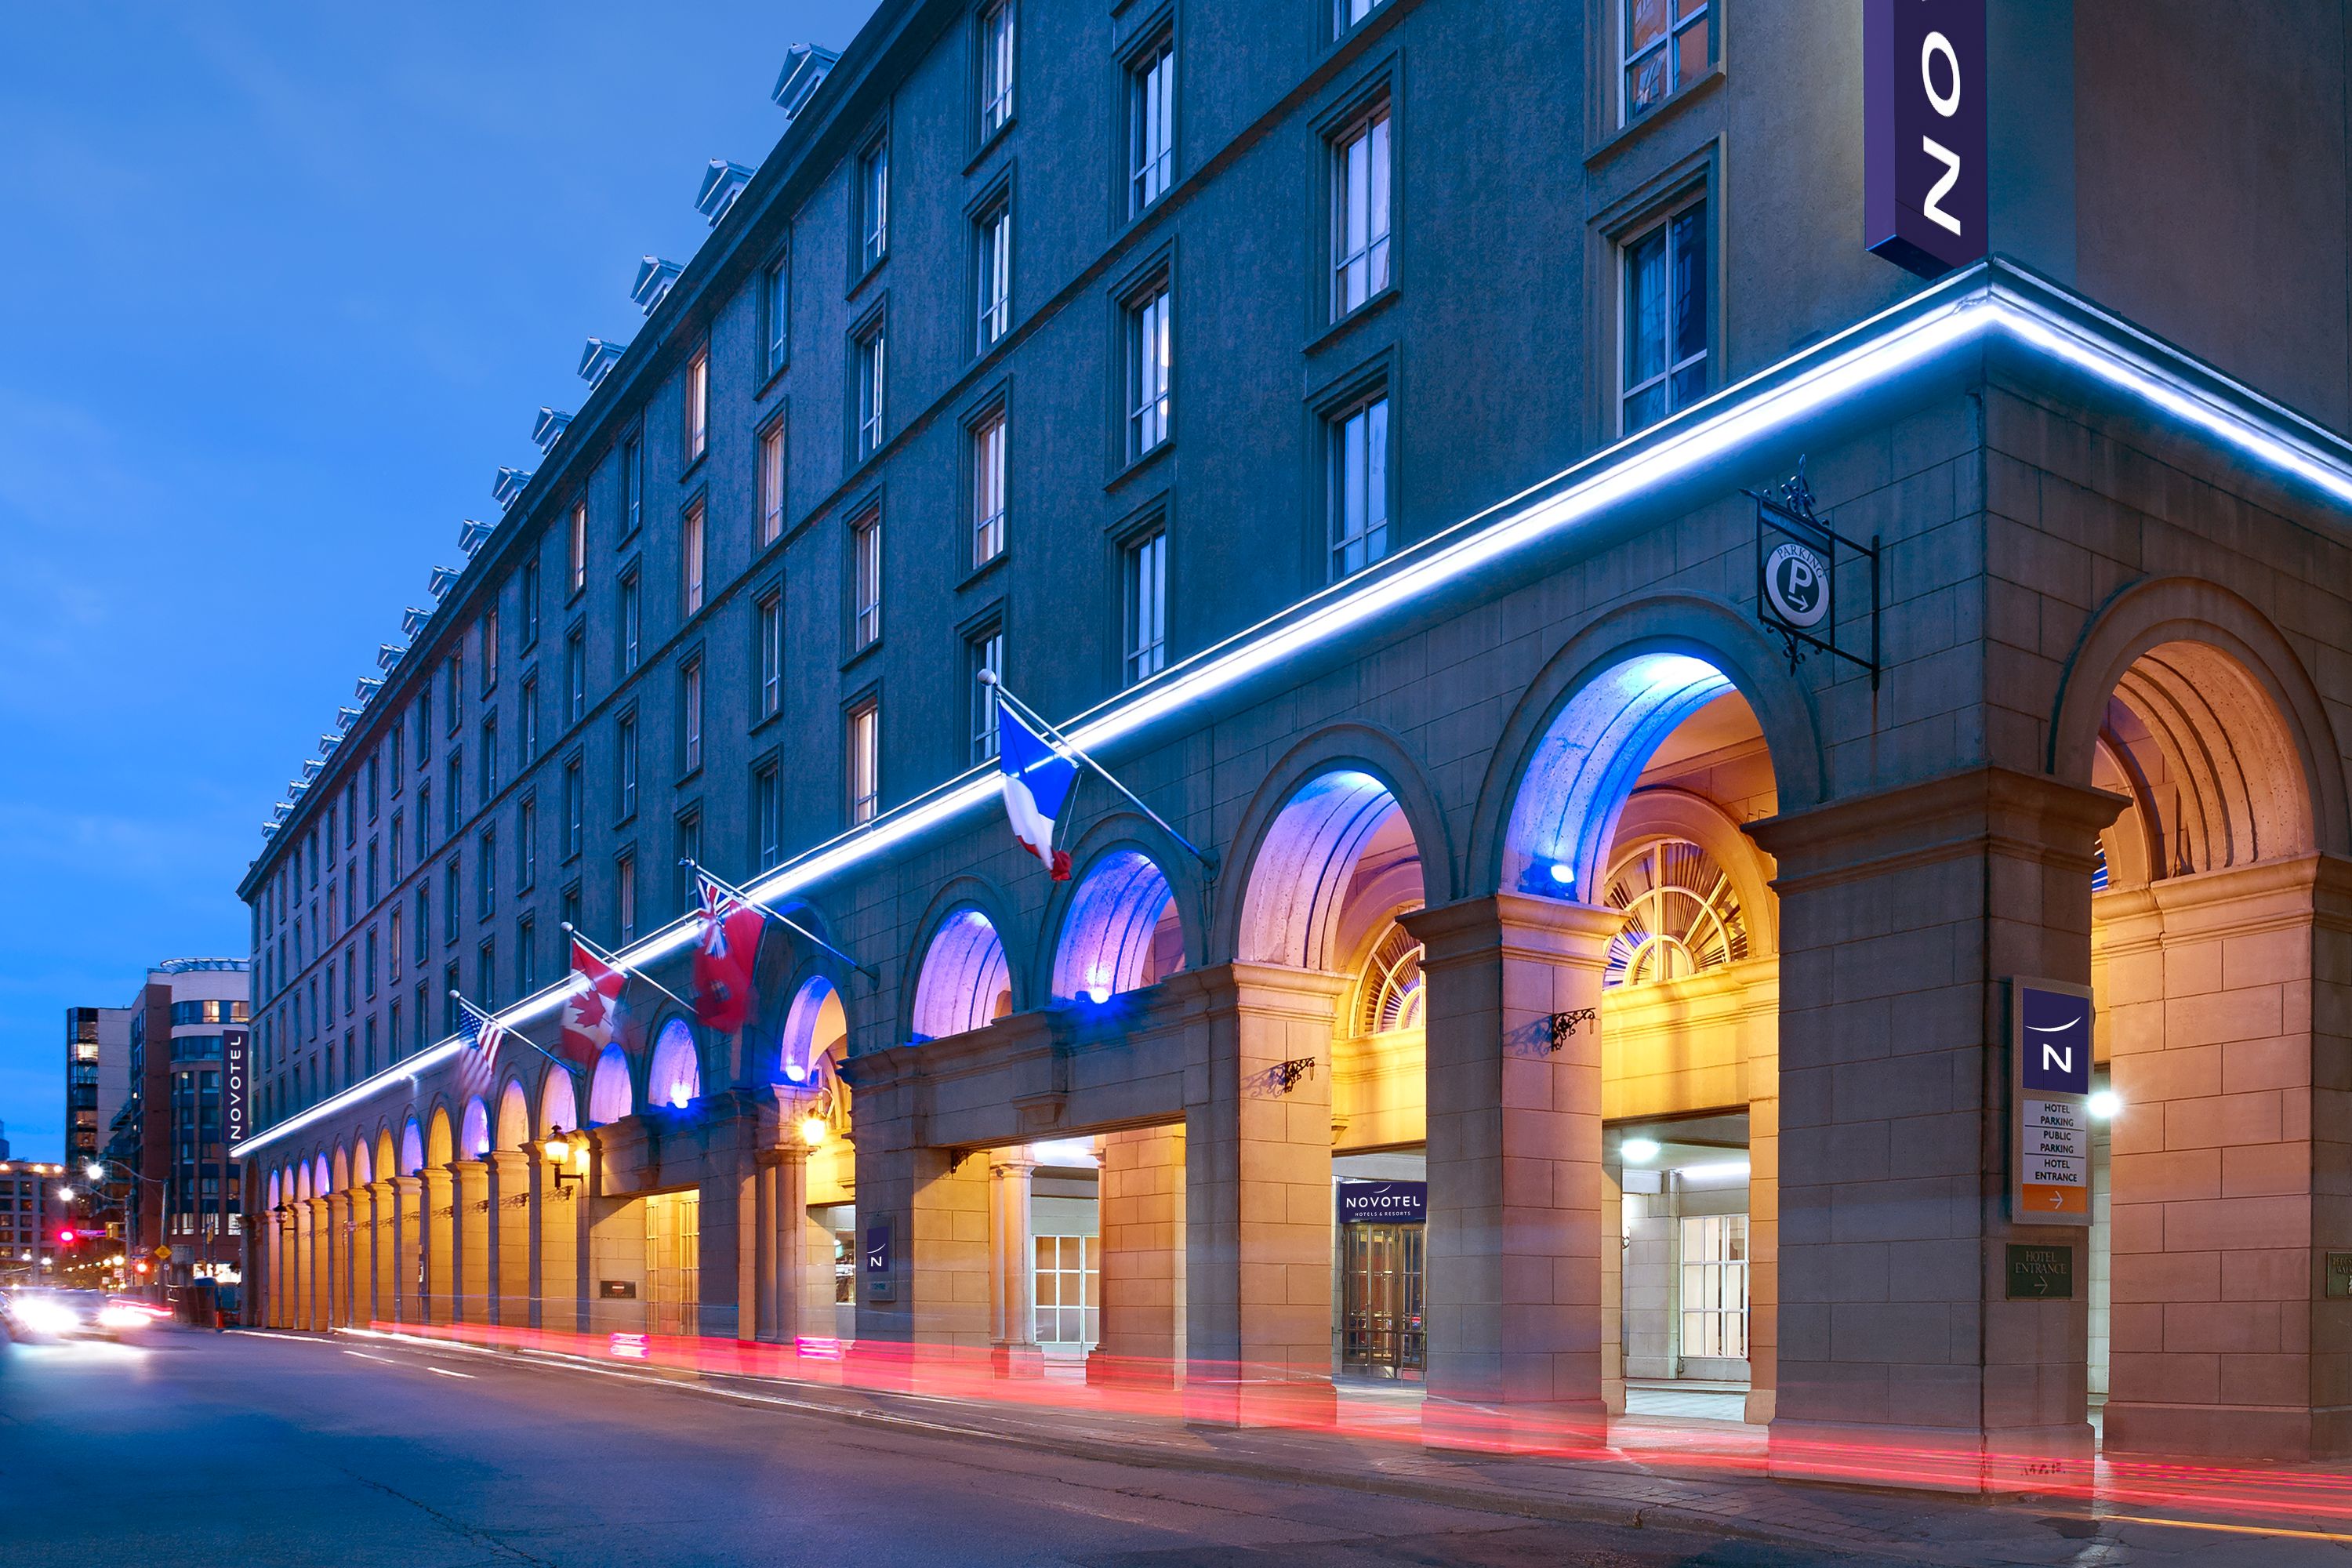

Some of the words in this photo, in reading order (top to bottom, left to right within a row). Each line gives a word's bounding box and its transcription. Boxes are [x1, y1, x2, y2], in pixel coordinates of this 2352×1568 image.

[1922, 0, 1962, 237] NO
[1777, 545, 1825, 578] PARKING
[1788, 559, 1813, 594] P
[2043, 1044, 2071, 1073] N
[230, 1036, 241, 1139] NOVOTEL
[2044, 1103, 2071, 1113] HOTEL
[2040, 1116, 2074, 1127] PARKING
[2043, 1131, 2071, 1141] PUBLIC
[2040, 1143, 2074, 1153] PARKING
[2044, 1159, 2071, 1169] HOTEL
[2034, 1171, 2078, 1182] ENTRANCE
[1346, 1196, 1421, 1208] NOVOTEL
[870, 1256, 882, 1267] N
[2026, 1250, 2056, 1262] HOTEL
[2015, 1262, 2067, 1274] ENTRANCE
